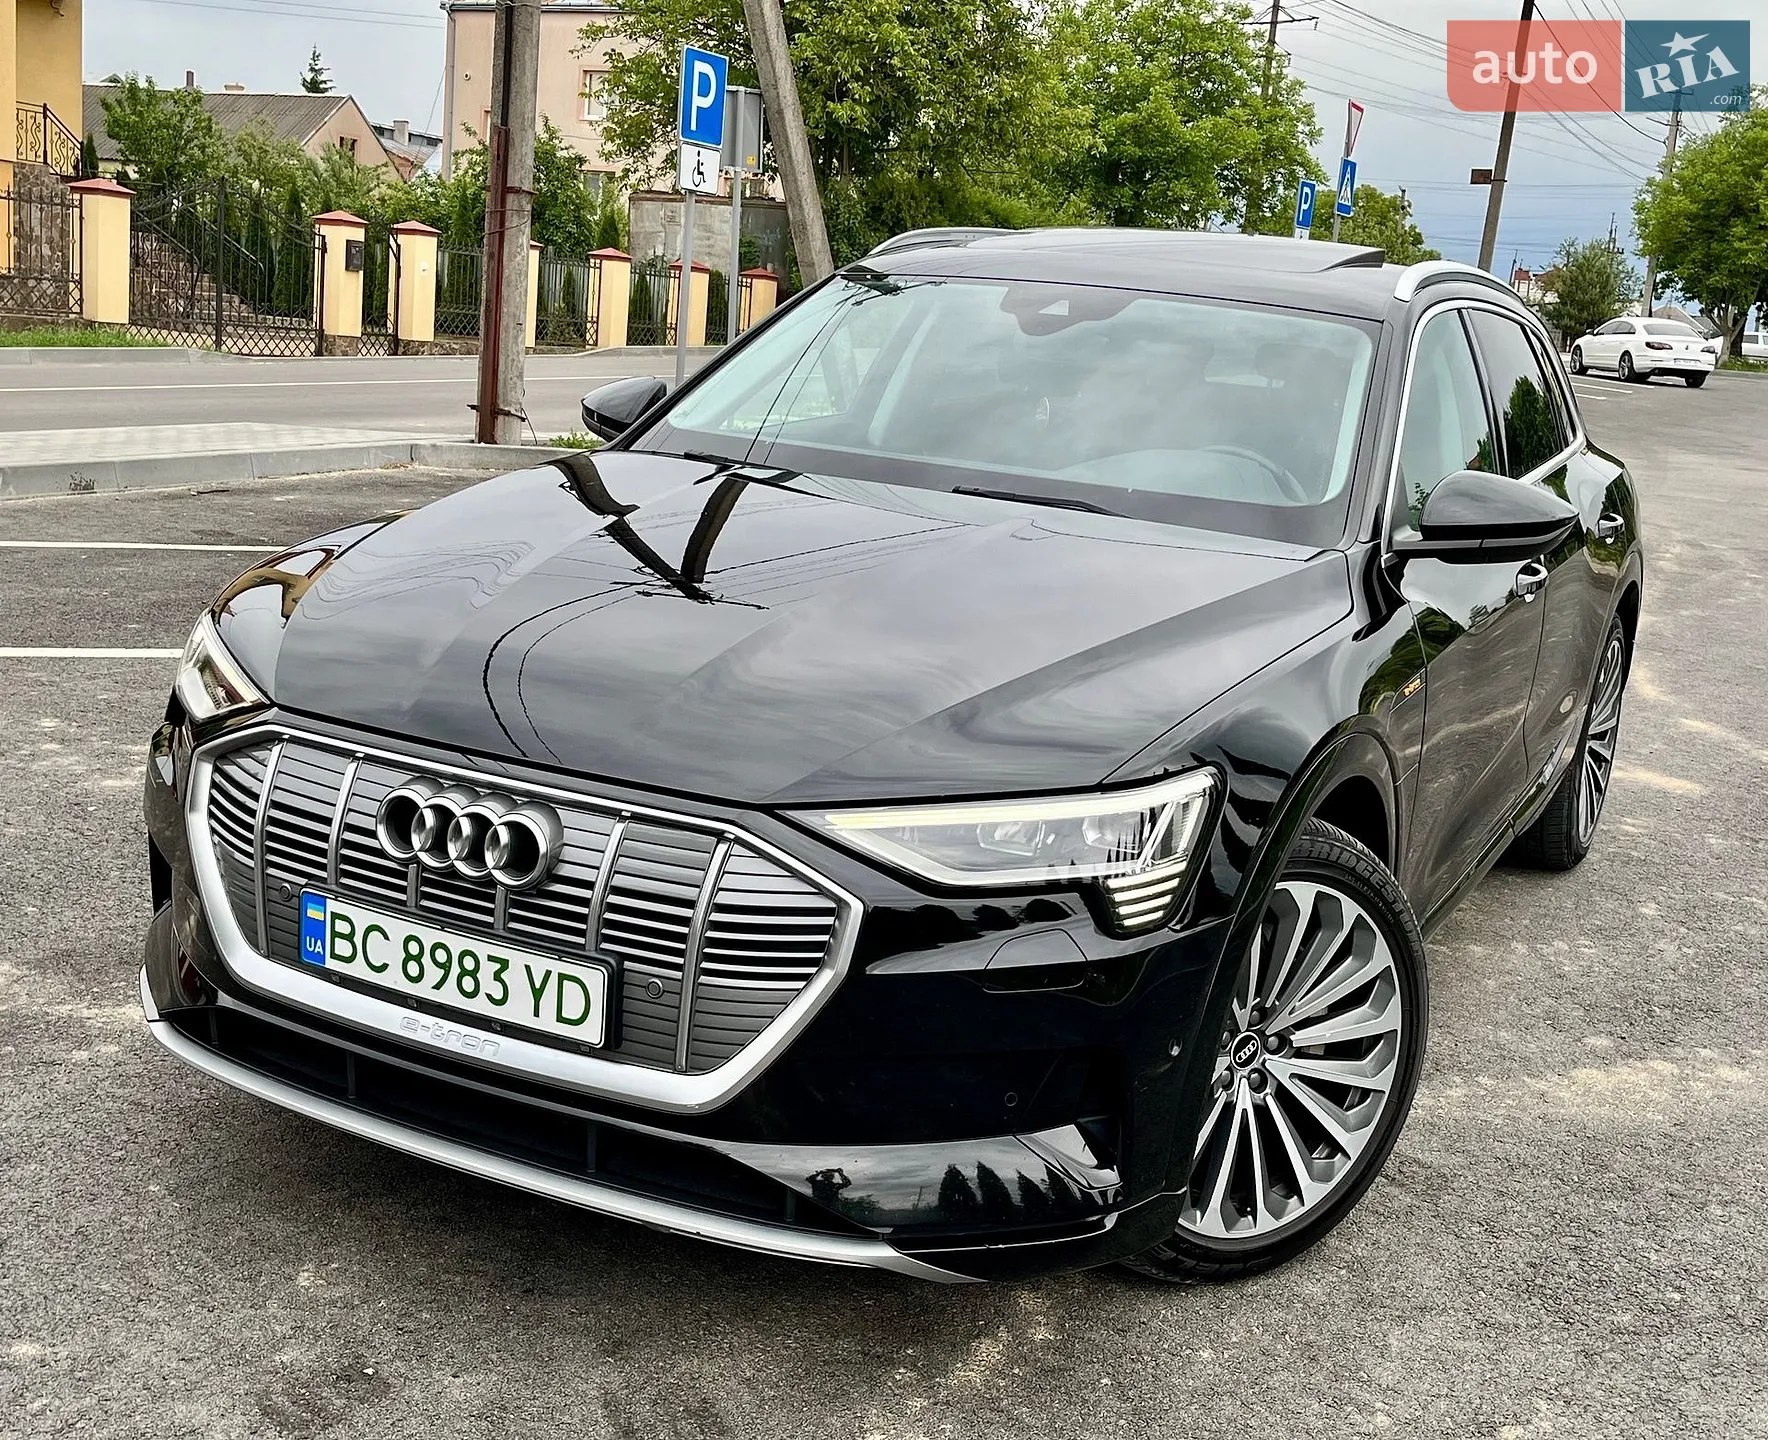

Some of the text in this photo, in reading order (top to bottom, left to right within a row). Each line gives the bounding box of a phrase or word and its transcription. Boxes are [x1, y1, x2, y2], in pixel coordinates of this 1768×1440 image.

[690, 59, 717, 132] P
[1299, 186, 1311, 222] P
[1289, 840, 1424, 957] BRIDGESTONE
[306, 936, 324, 955] UA
[329, 910, 591, 1026] BC 8983 YD
[400, 1016, 501, 1057] e-tron
